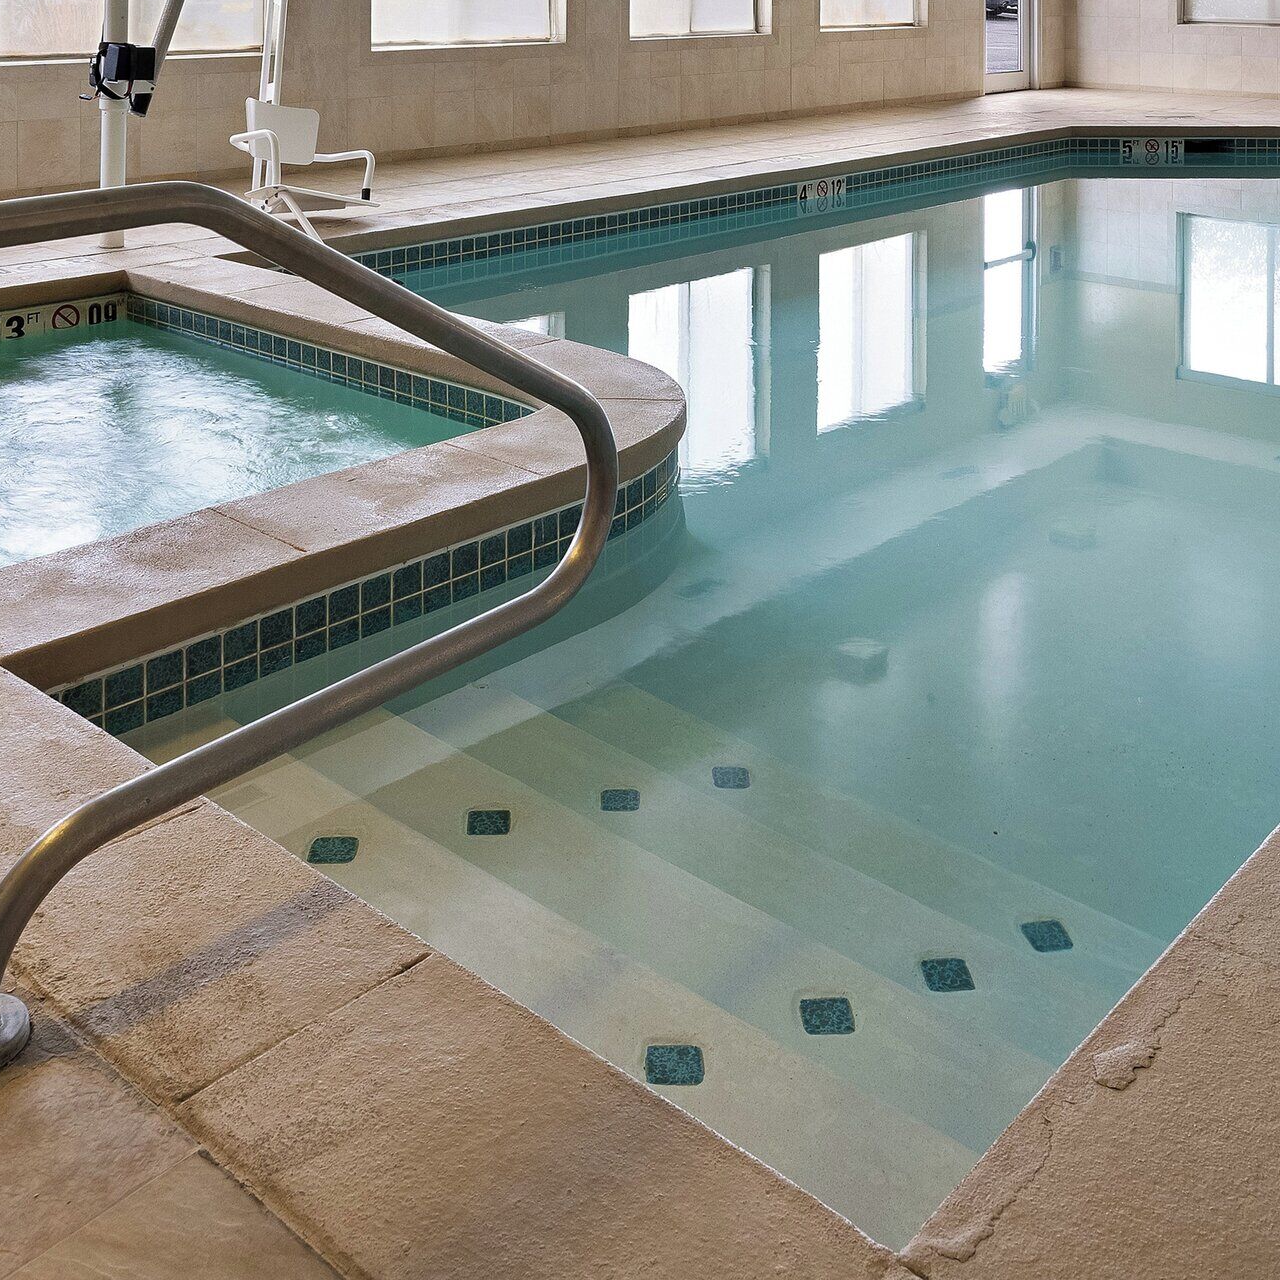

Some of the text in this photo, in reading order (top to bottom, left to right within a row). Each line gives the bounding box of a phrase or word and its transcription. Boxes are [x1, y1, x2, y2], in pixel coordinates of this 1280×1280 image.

[799, 184, 808, 200] 4
[5, 315, 26, 339] 3
[26, 311, 41, 325] FT
